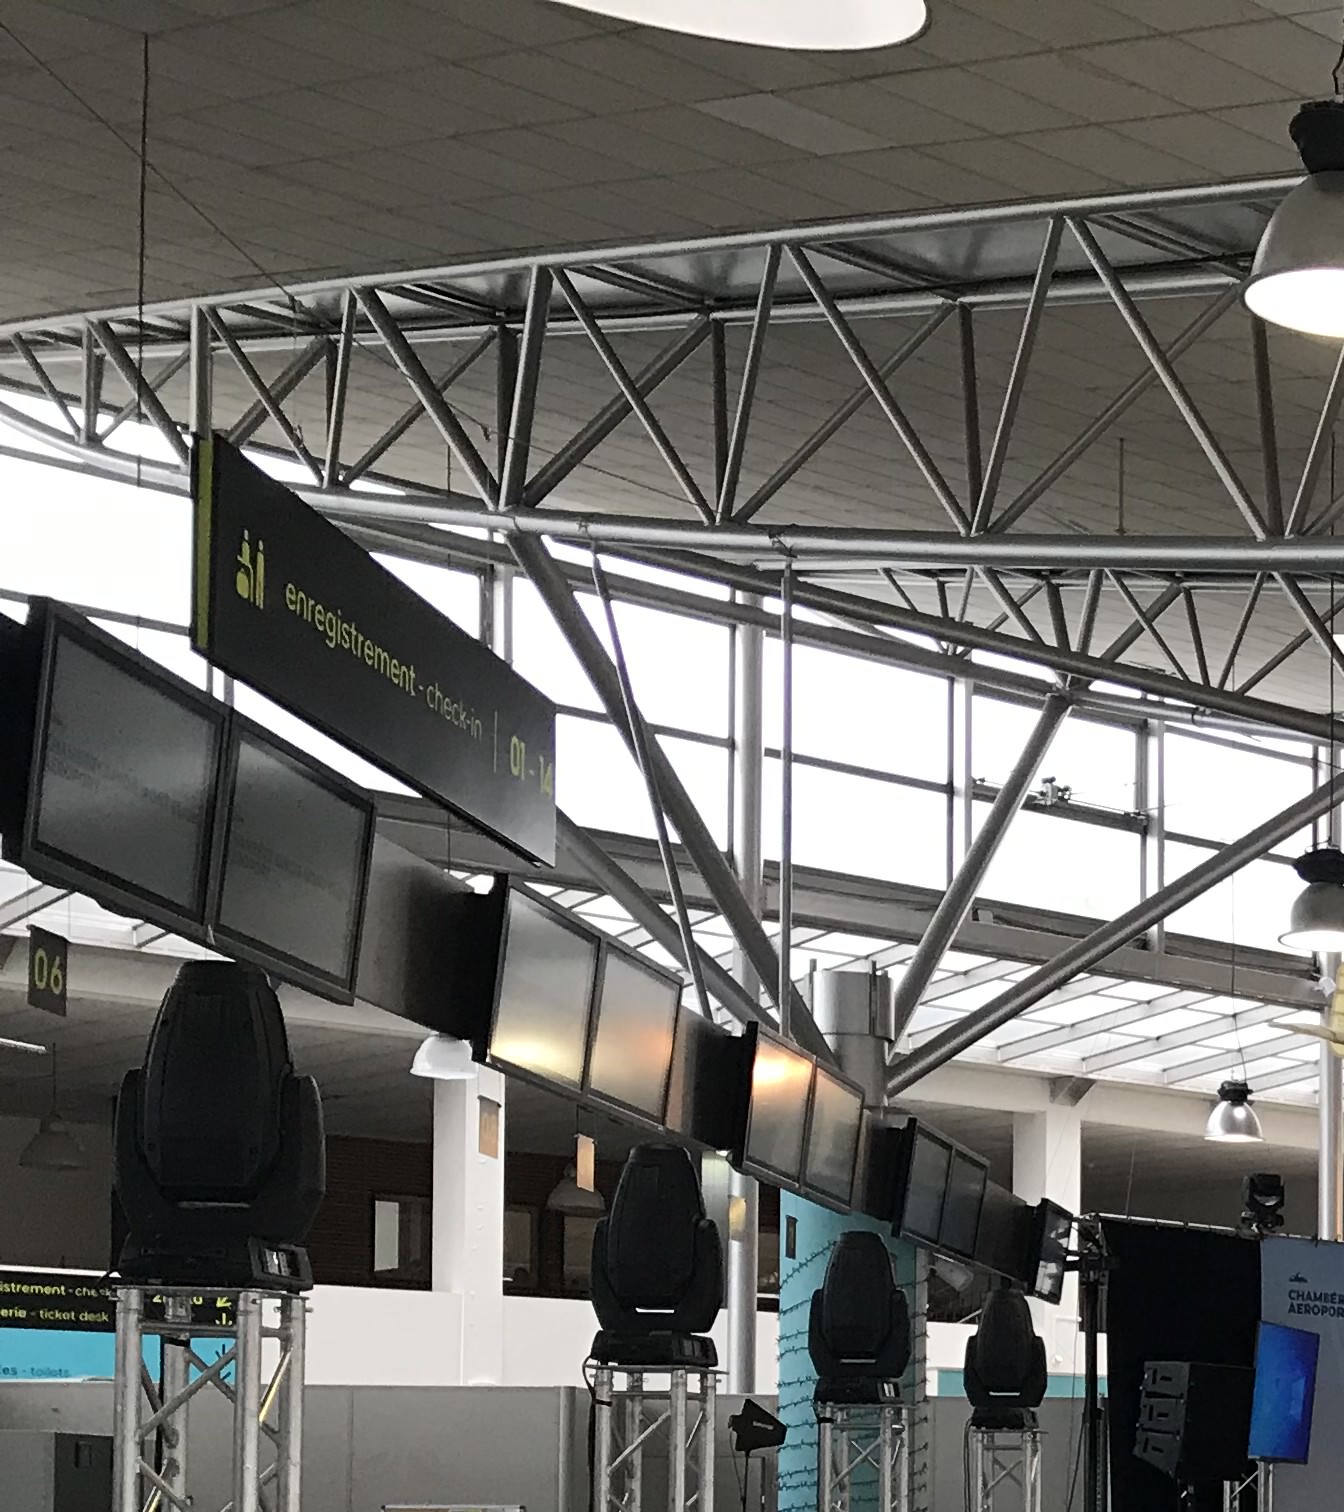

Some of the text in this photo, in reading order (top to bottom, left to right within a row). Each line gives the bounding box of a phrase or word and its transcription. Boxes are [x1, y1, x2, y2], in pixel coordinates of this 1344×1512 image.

[286, 583, 416, 696] enregistrement
[426, 682, 482, 741] check-in
[510, 735, 525, 780] 01
[539, 755, 552, 794] 14
[35, 948, 62, 995] 06
[40, 1309, 76, 1322] ticket
[79, 1311, 109, 1323] desk
